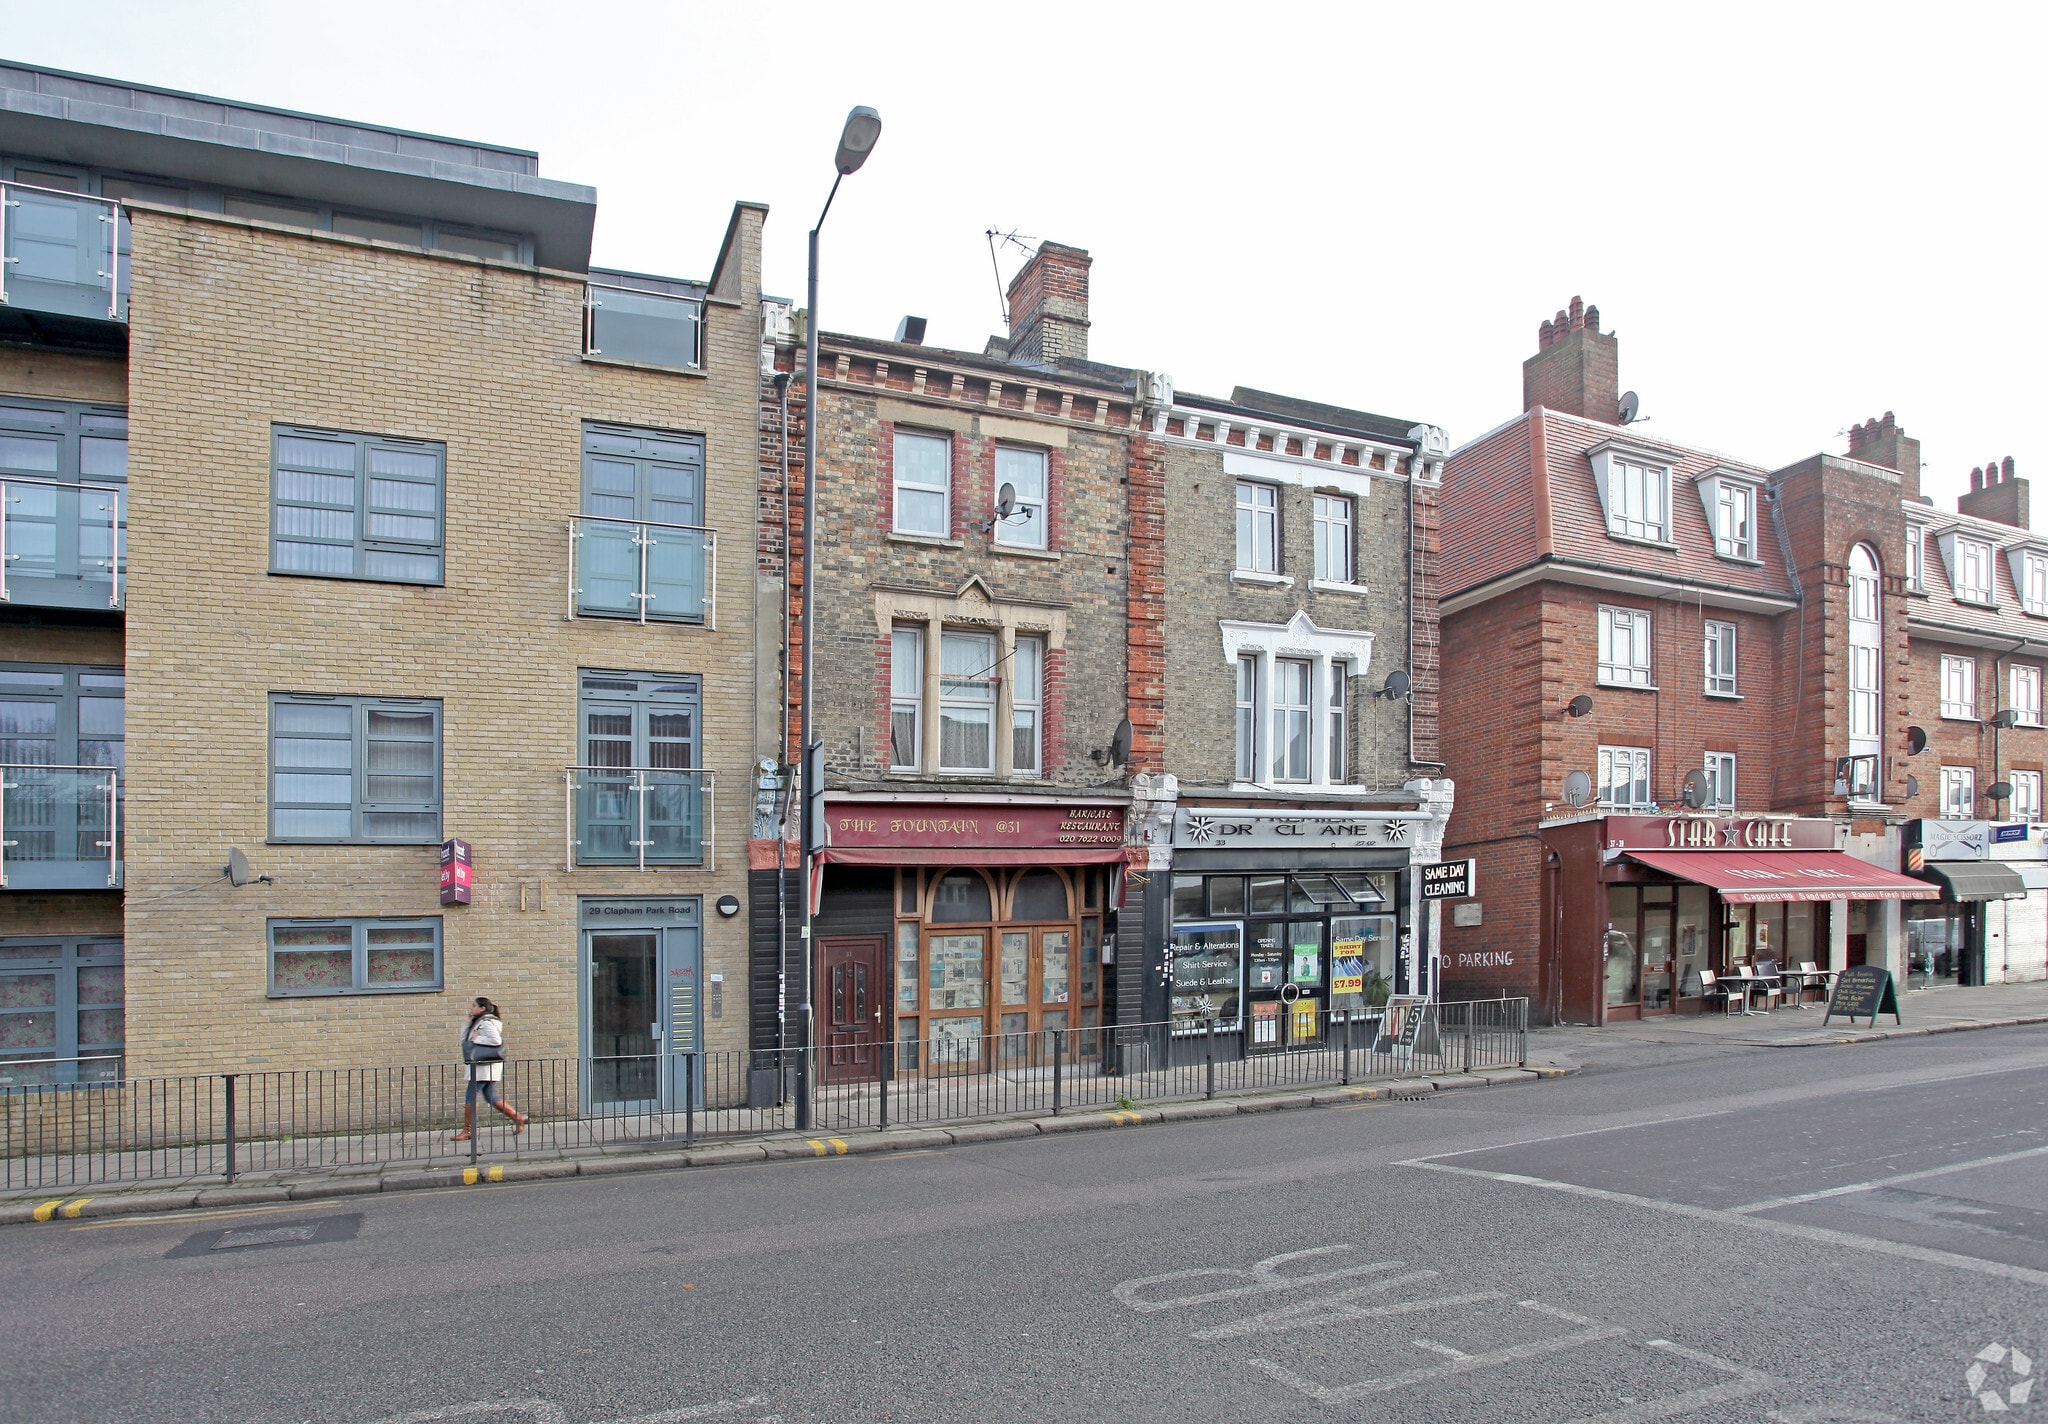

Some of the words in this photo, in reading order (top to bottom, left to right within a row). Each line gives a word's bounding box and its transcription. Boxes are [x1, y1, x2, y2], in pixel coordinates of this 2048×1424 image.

[839, 818, 878, 832] THE
[890, 818, 979, 834] FOUNTAIN
[996, 820, 1020, 833] @31
[1060, 821, 1121, 832] RESTAURANT
[1667, 819, 1716, 847] STAR
[1744, 820, 1792, 847] CAFE
[1930, 833, 1951, 841] MAGIC
[1953, 833, 1983, 841] SCISSORZ
[1059, 835, 1075, 843] 020
[1078, 835, 1098, 843] 7622
[1100, 835, 1122, 843] 0009
[1215, 839, 1226, 847] 33
[1424, 866, 1448, 881] SAME
[1450, 864, 1466, 878] DAY
[1424, 880, 1466, 896] CLEANING
[1743, 892, 1793, 901] Cappuccino
[1799, 891, 1847, 900] Sandwiches
[589, 907, 601, 915] 29
[604, 906, 643, 916] Clapham
[646, 906, 665, 914] Park
[668, 906, 691, 914] Road
[1335, 935, 1354, 943] Same
[1354, 935, 1367, 943] Day
[1172, 943, 1193, 952] Repair
[1195, 942, 1201, 950] &
[1203, 942, 1240, 950] Alterations
[1458, 950, 1514, 968] PARKING
[1182, 961, 1201, 970] Shirt
[1202, 960, 1228, 968] Service
[1175, 979, 1198, 987] Suede
[1200, 978, 1206, 986] &
[1208, 977, 1234, 985] Leather
[1333, 978, 1361, 989] £7.99
